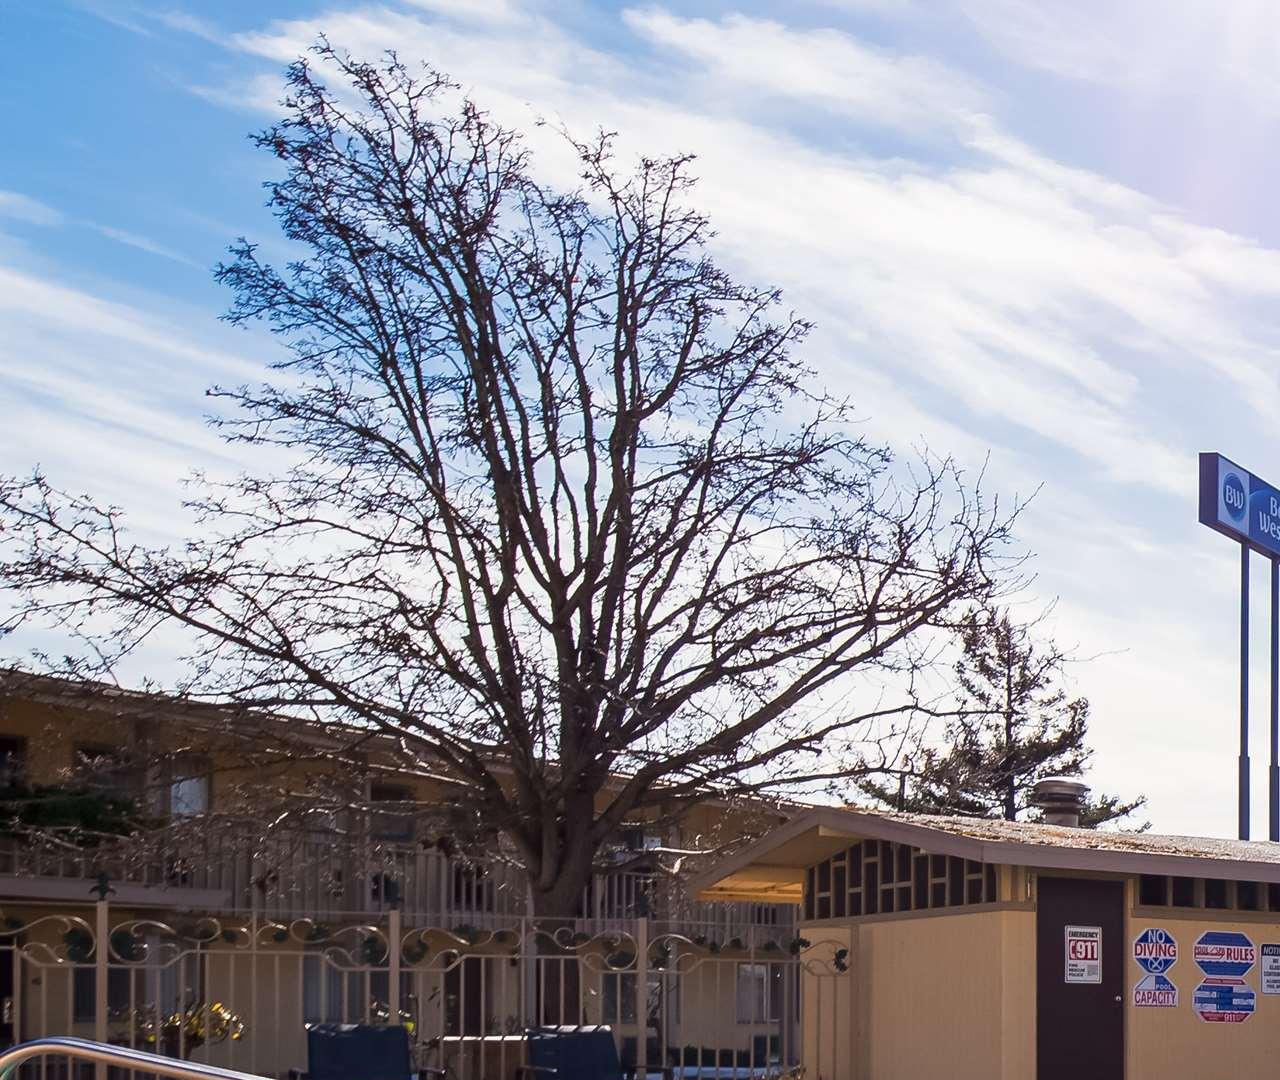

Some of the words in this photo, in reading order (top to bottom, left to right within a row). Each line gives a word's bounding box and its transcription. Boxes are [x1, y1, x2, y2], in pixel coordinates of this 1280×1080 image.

[1225, 485, 1244, 509] BW
[1148, 929, 1165, 943] NO
[1076, 941, 1098, 959] 911
[1135, 943, 1176, 957] DIVING
[1226, 948, 1255, 961] RULES
[1135, 991, 1177, 1004] CAPACITY
